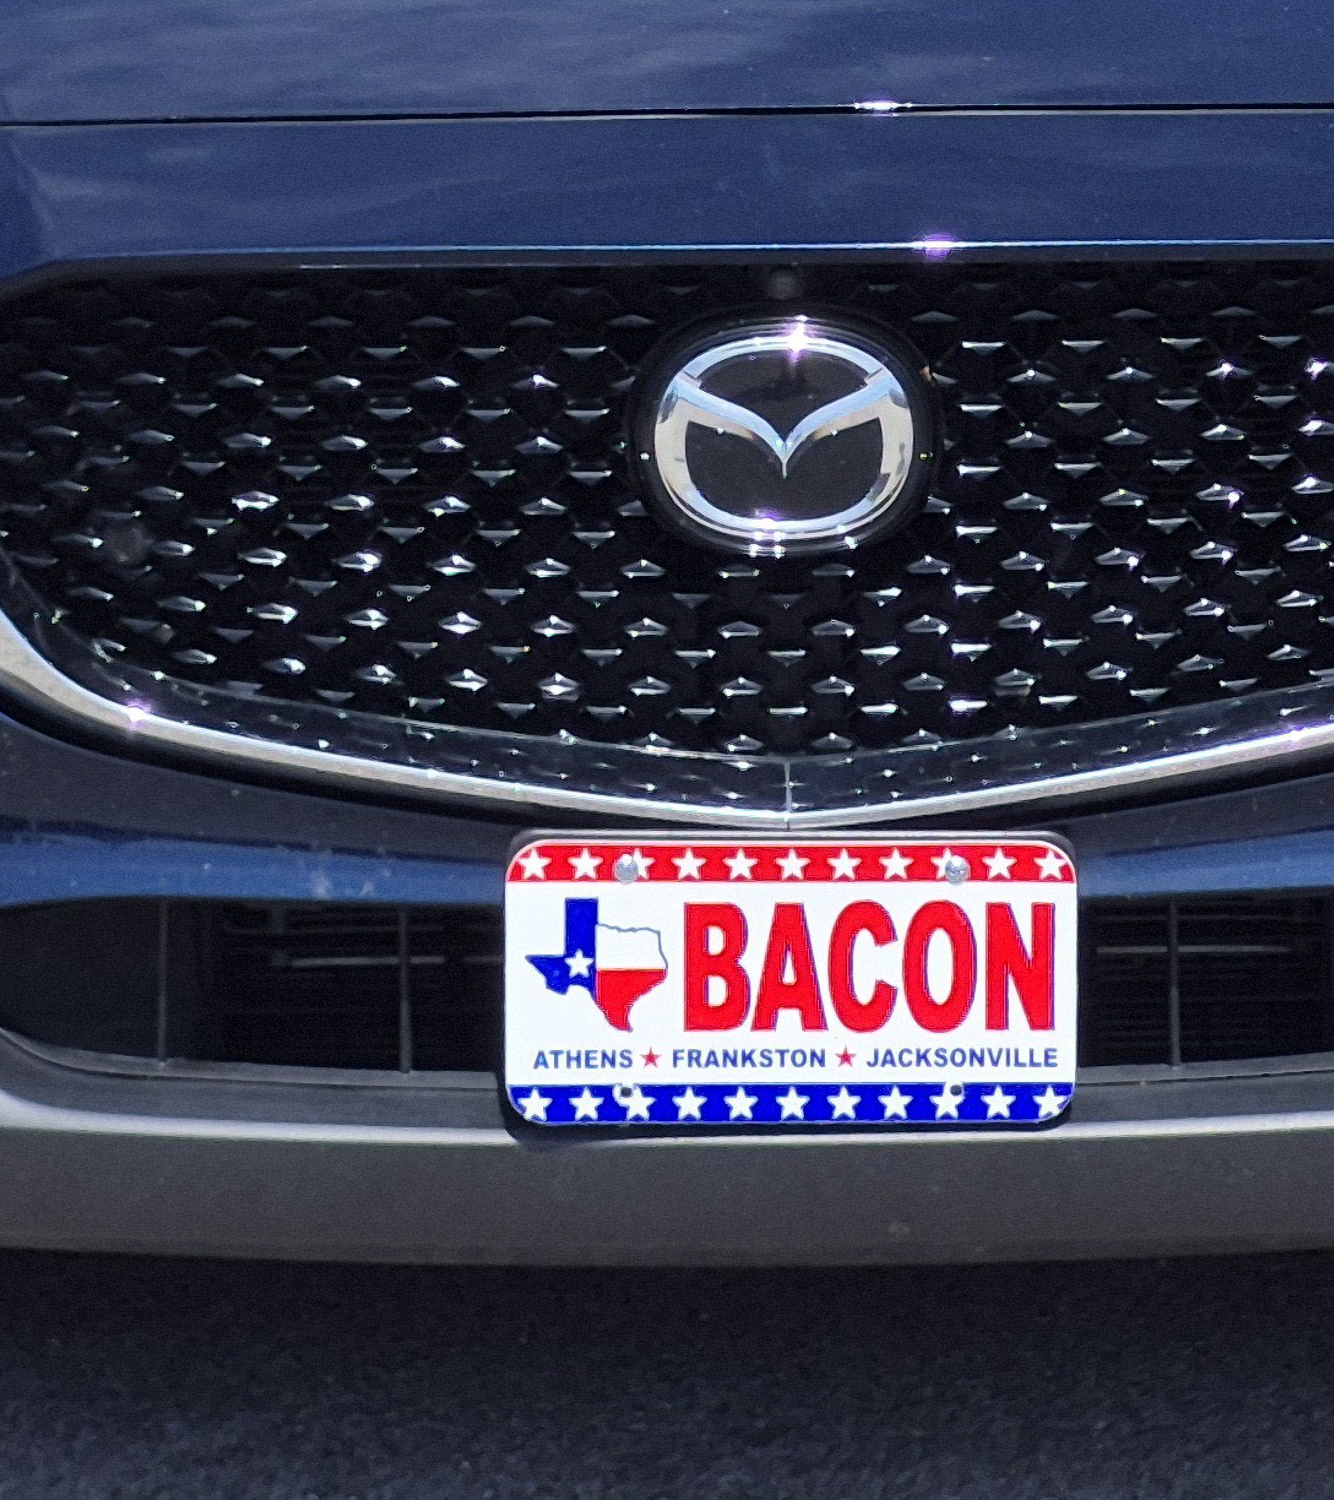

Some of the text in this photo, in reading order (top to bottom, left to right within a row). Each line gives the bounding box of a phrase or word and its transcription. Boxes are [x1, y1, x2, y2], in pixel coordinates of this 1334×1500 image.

[684, 900, 1056, 1033] BACON
[534, 1047, 1058, 1069] ATHENS FRANKSTON JACKSONVILLE
